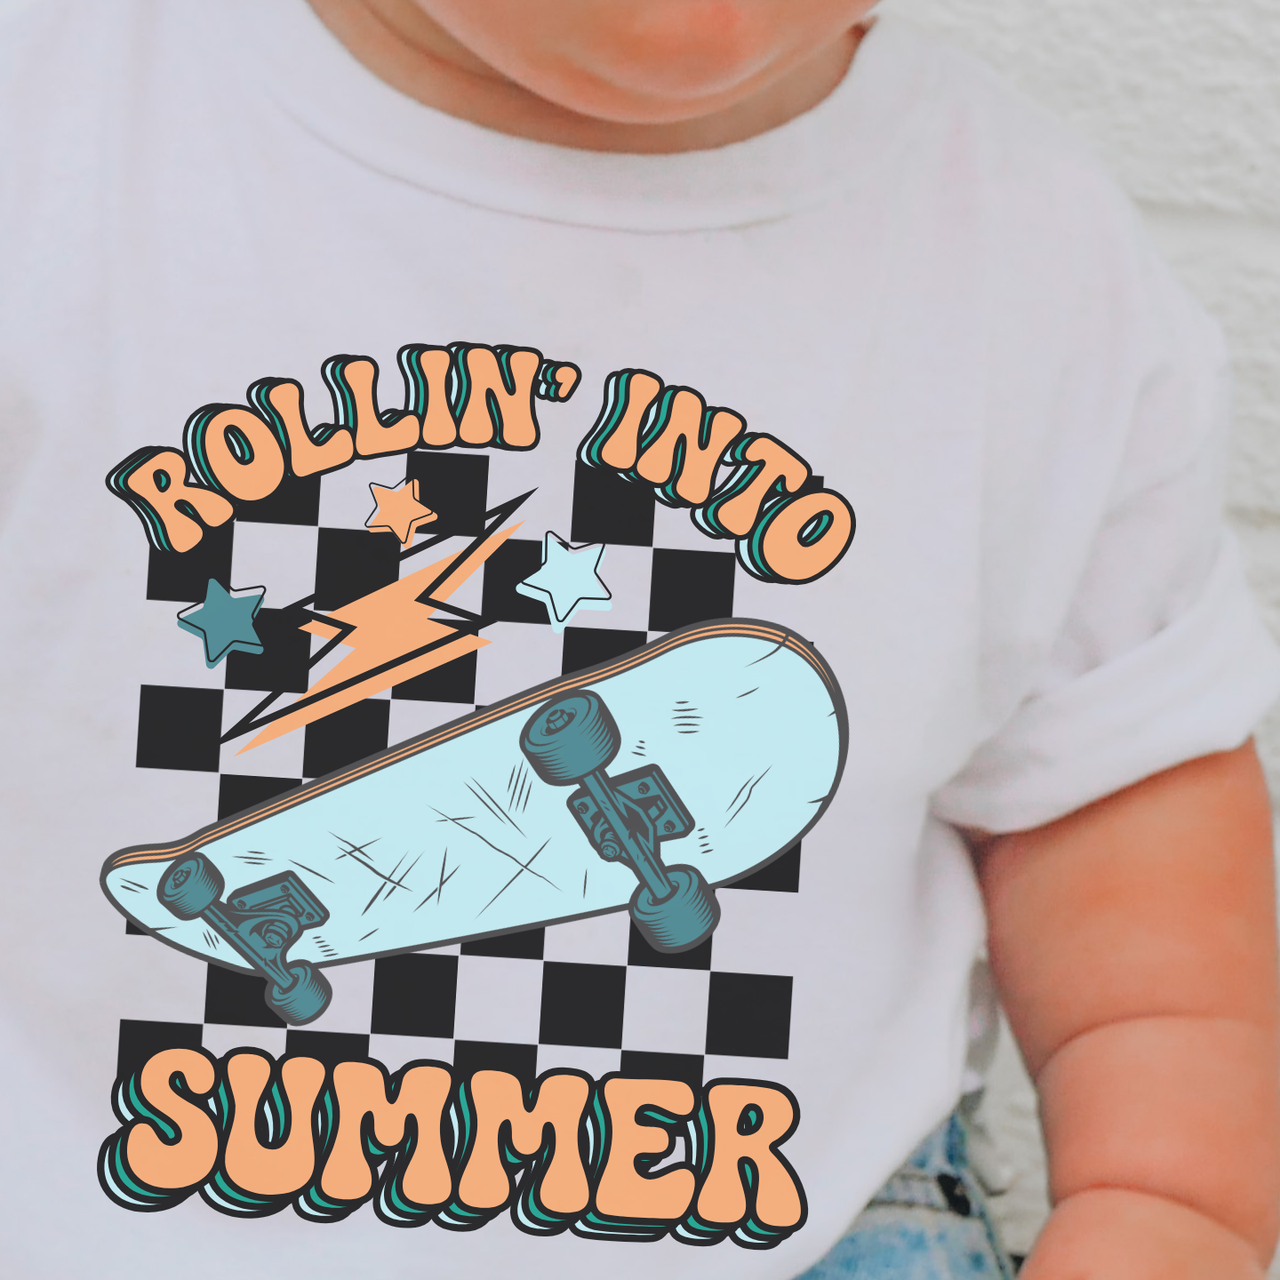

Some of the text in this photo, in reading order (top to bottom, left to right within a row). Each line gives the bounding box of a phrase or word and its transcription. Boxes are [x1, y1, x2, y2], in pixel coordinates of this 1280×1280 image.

[106, 342, 856, 584] ROLLIN' INTO
[98, 1045, 808, 1250] SUMMER
